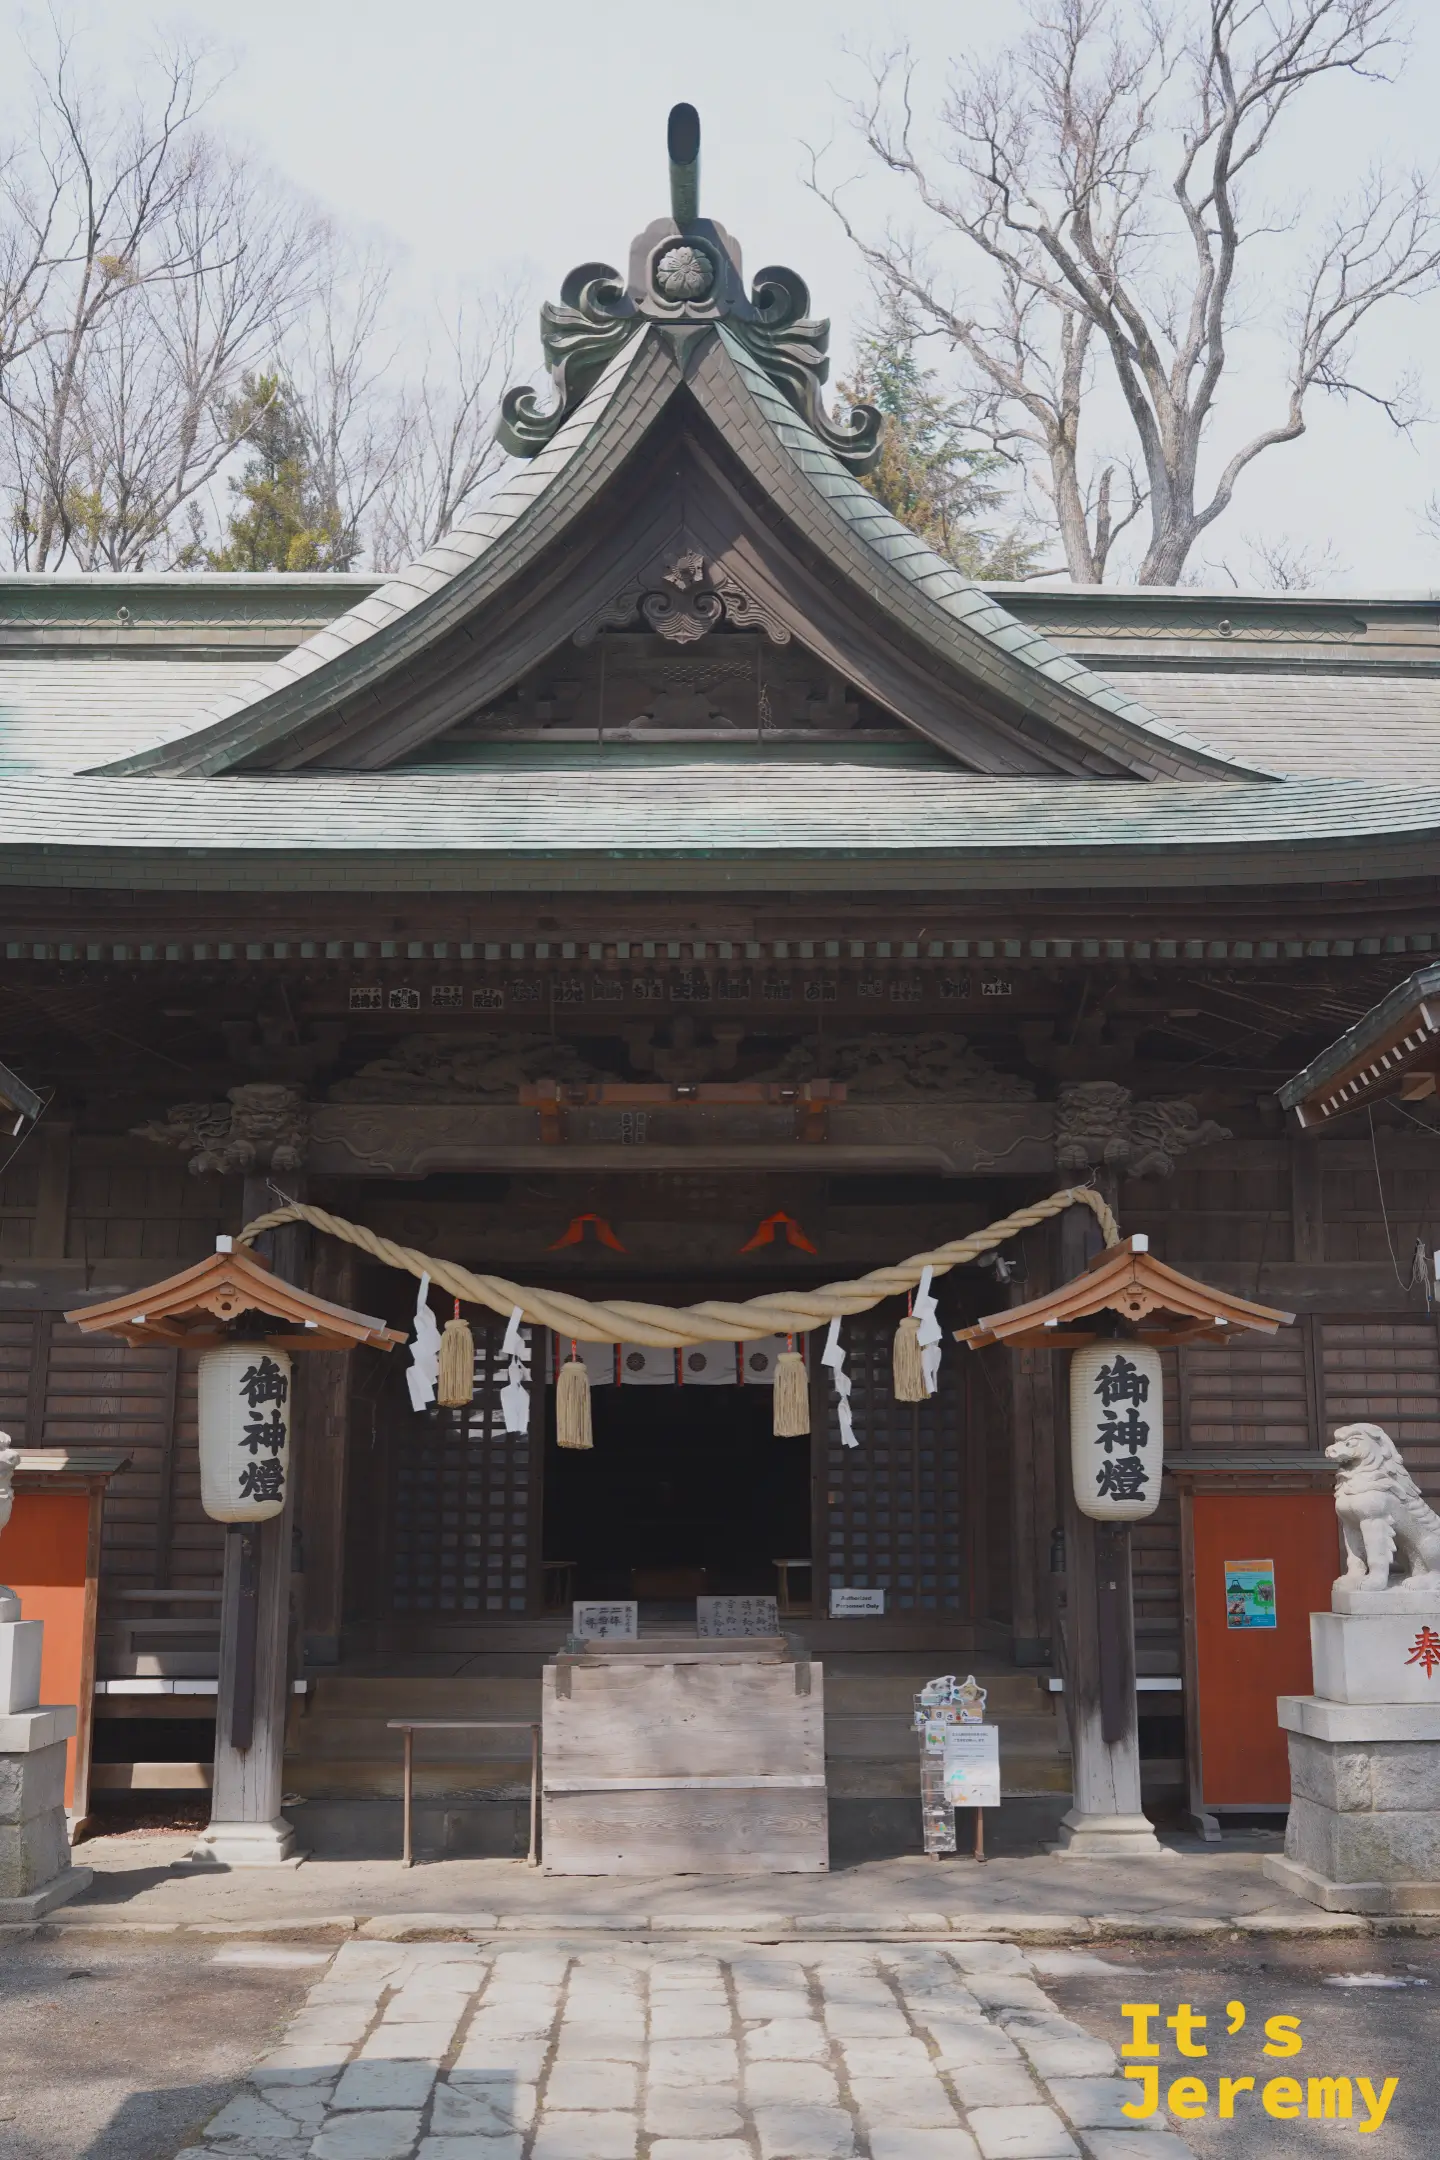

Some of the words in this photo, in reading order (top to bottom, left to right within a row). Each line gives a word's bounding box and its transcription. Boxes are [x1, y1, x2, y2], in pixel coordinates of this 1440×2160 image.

[238, 1355, 288, 1502] 御神燈
[1093, 1354, 1150, 1502] 御神燈
[1404, 1626, 1440, 1680] 奉
